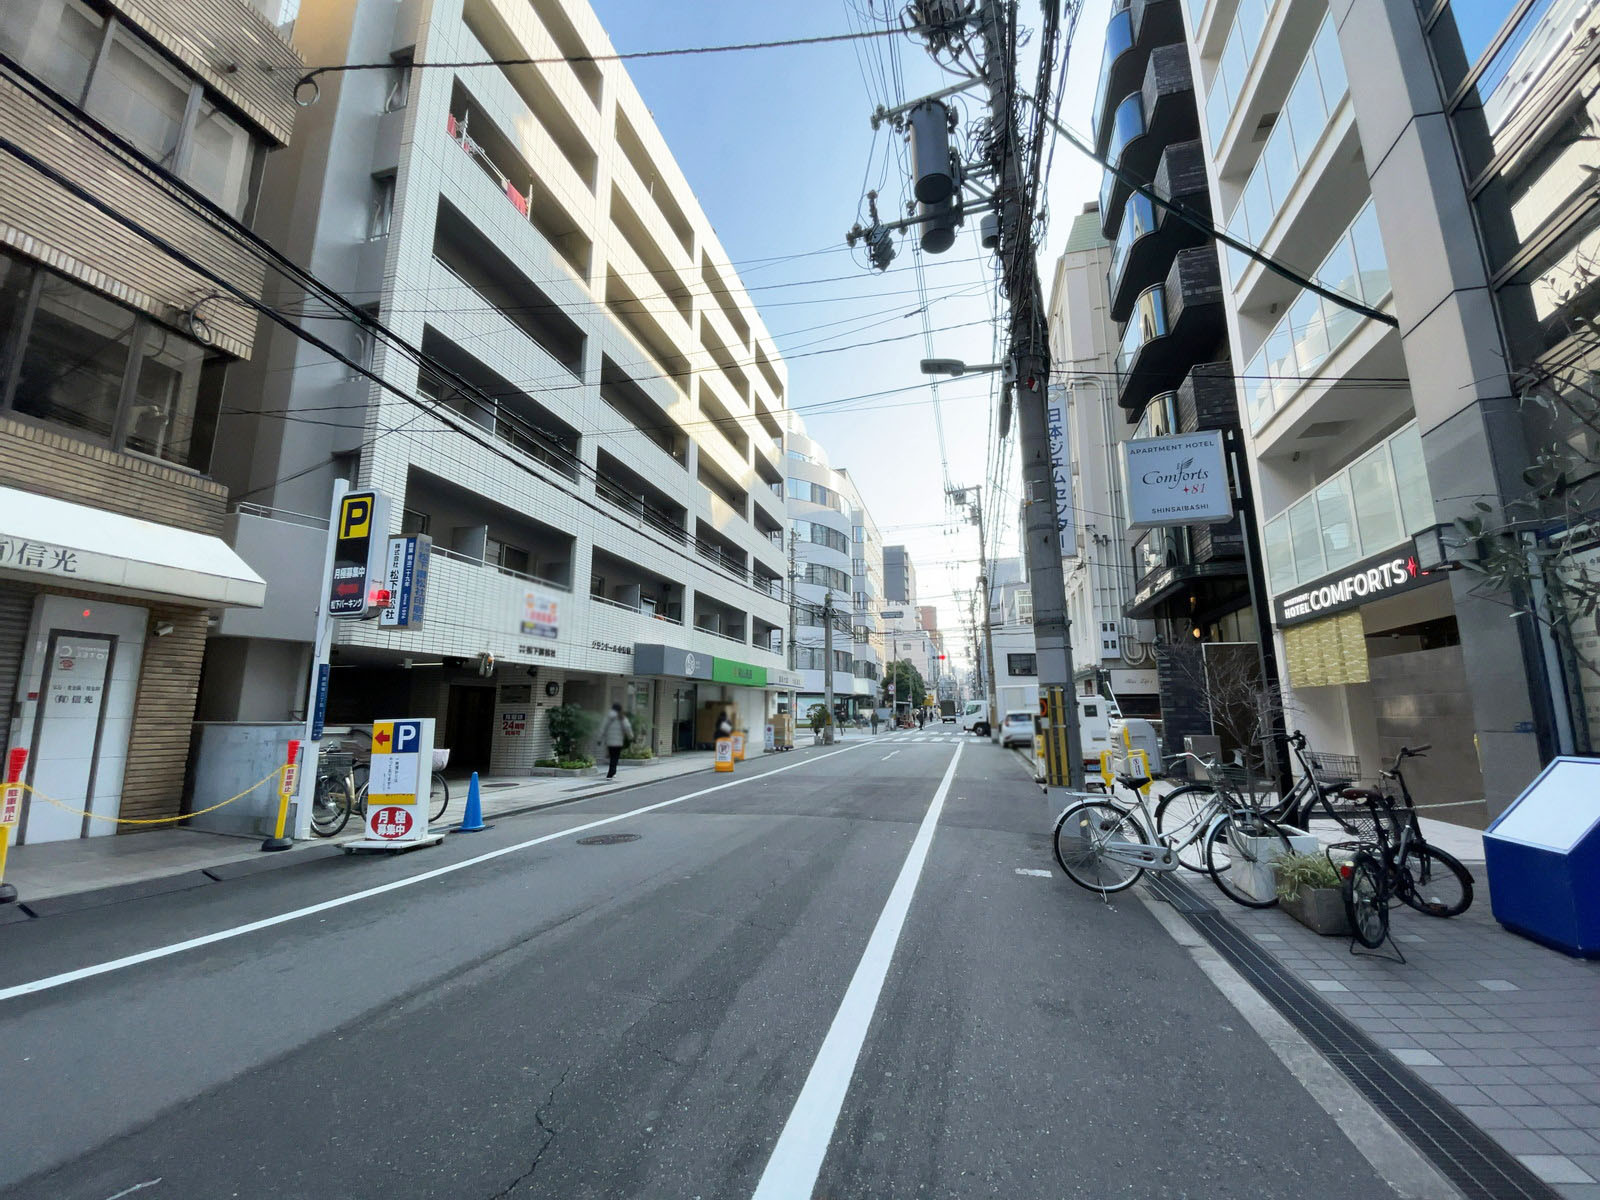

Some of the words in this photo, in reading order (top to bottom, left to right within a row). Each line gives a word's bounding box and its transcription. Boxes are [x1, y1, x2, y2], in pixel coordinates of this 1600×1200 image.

[1130, 444, 1182, 455] APARTMENT
[1185, 441, 1214, 449] HOTEL
[1142, 458, 1209, 489] Comforts
[344, 501, 368, 537] P
[1151, 504, 1209, 514] SHINSAIBASHI
[1284, 602, 1312, 619] HOTEL
[1309, 558, 1408, 611] COMFORTS
[398, 725, 417, 750] P
